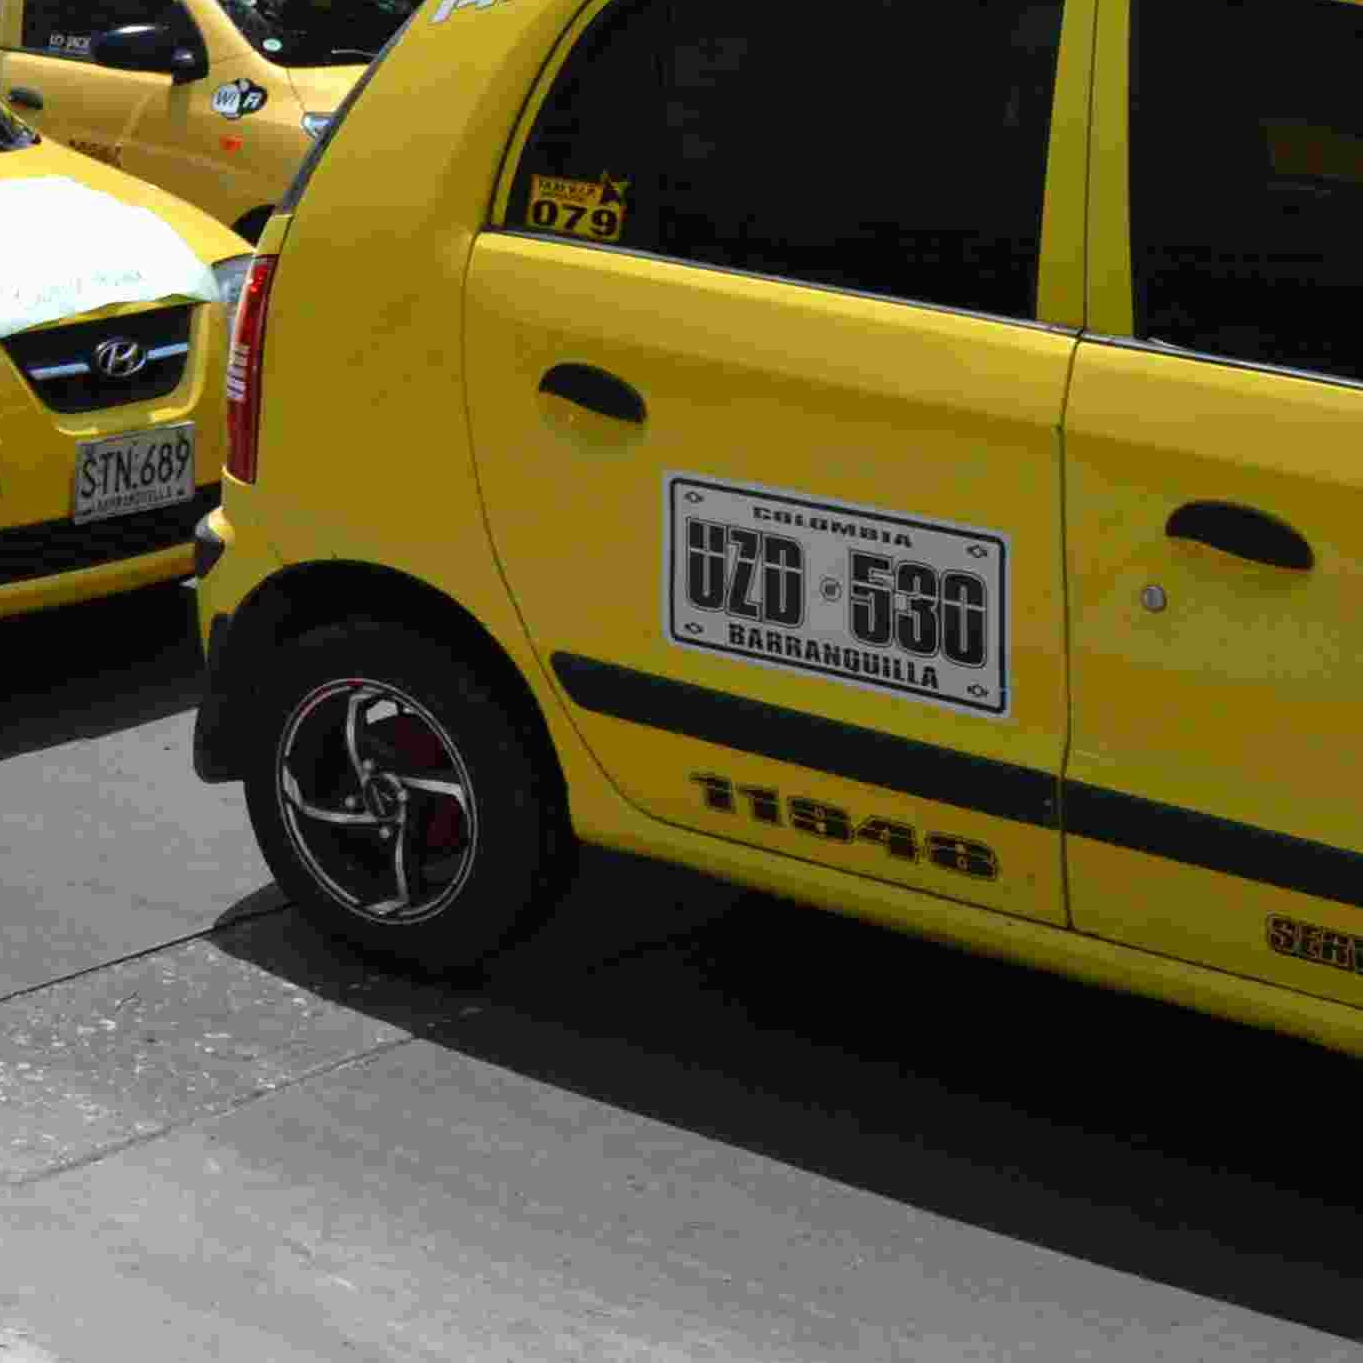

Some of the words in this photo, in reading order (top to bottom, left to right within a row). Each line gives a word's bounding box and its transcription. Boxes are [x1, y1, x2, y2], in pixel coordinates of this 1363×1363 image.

[532, 198, 619, 237] 079
[753, 506, 913, 548] COLOMBIA
[686, 517, 805, 630] UZD
[849, 547, 988, 670] 530
[728, 622, 940, 690] BARRANQUILLA
